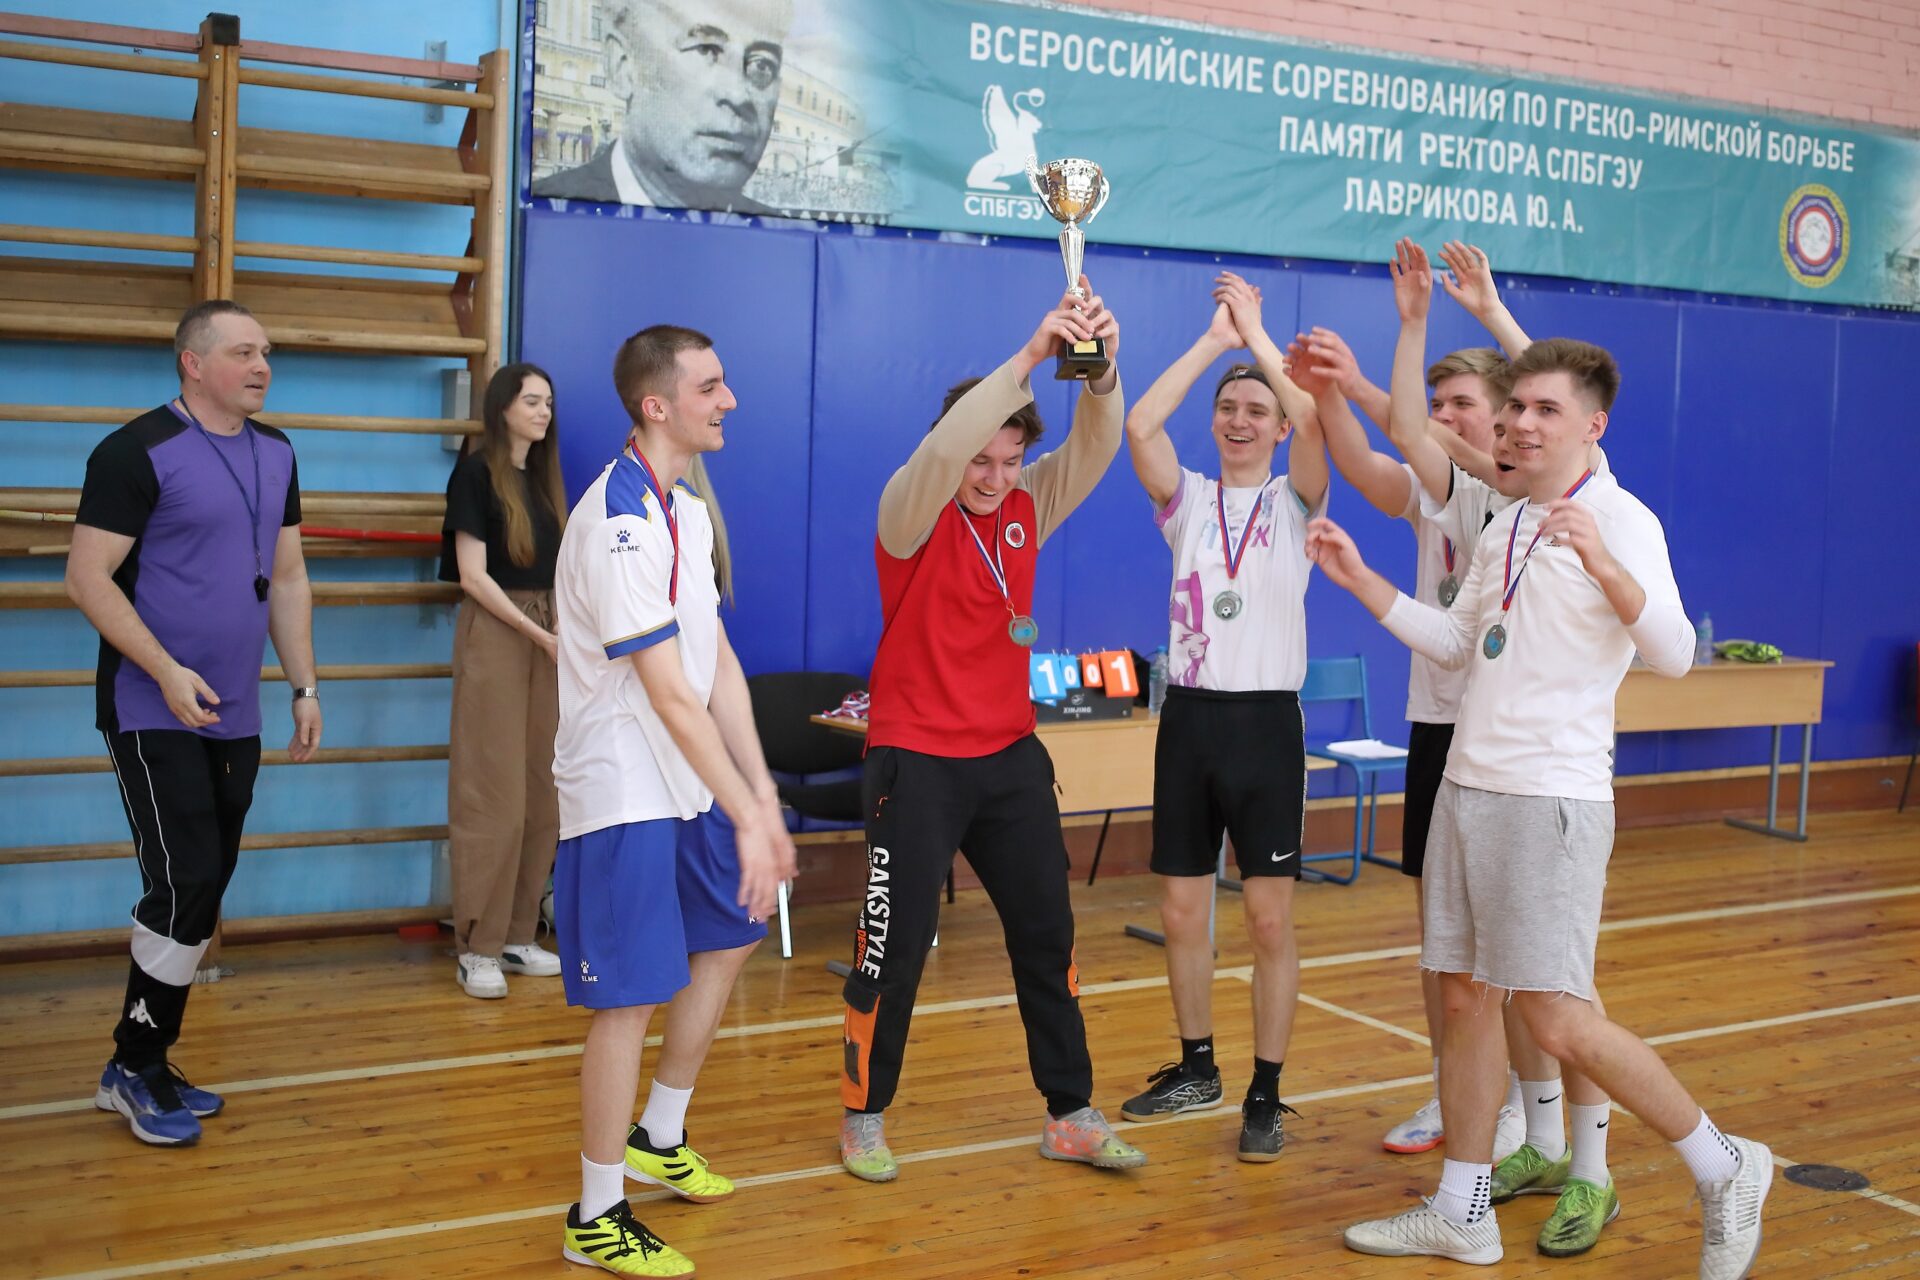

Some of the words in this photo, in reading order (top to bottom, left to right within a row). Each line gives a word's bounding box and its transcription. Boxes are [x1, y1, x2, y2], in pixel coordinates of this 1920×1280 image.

[970, 22, 1264, 94] ВСЕРОССИЙСКИЕ
[1272, 60, 1506, 122] СОРЕВНОВАНИЯ
[1513, 91, 1547, 127] ПО
[1554, 97, 1761, 159] ГРЕКО-РИМСКОЙ
[1767, 130, 1855, 172] БОРЬБЕ
[1279, 116, 1403, 163] ПАМЯТИ
[1419, 132, 1541, 178] РЕКТОРА
[1546, 147, 1643, 190] СПБГЭУ
[964, 196, 1045, 220] СПБГЭУ
[1344, 177, 1518, 226] ЛАВРИКОВА
[1526, 193, 1556, 229] Ю.
[1562, 199, 1584, 233] А.
[610, 545, 641, 554] KELME
[1037, 659, 1058, 695] 1
[1064, 665, 1077, 686] 0
[1086, 663, 1100, 684] 0
[1111, 655, 1131, 692] 1
[860, 846, 890, 980] GAKSTYLE
[856, 929, 866, 969] DESIGN
